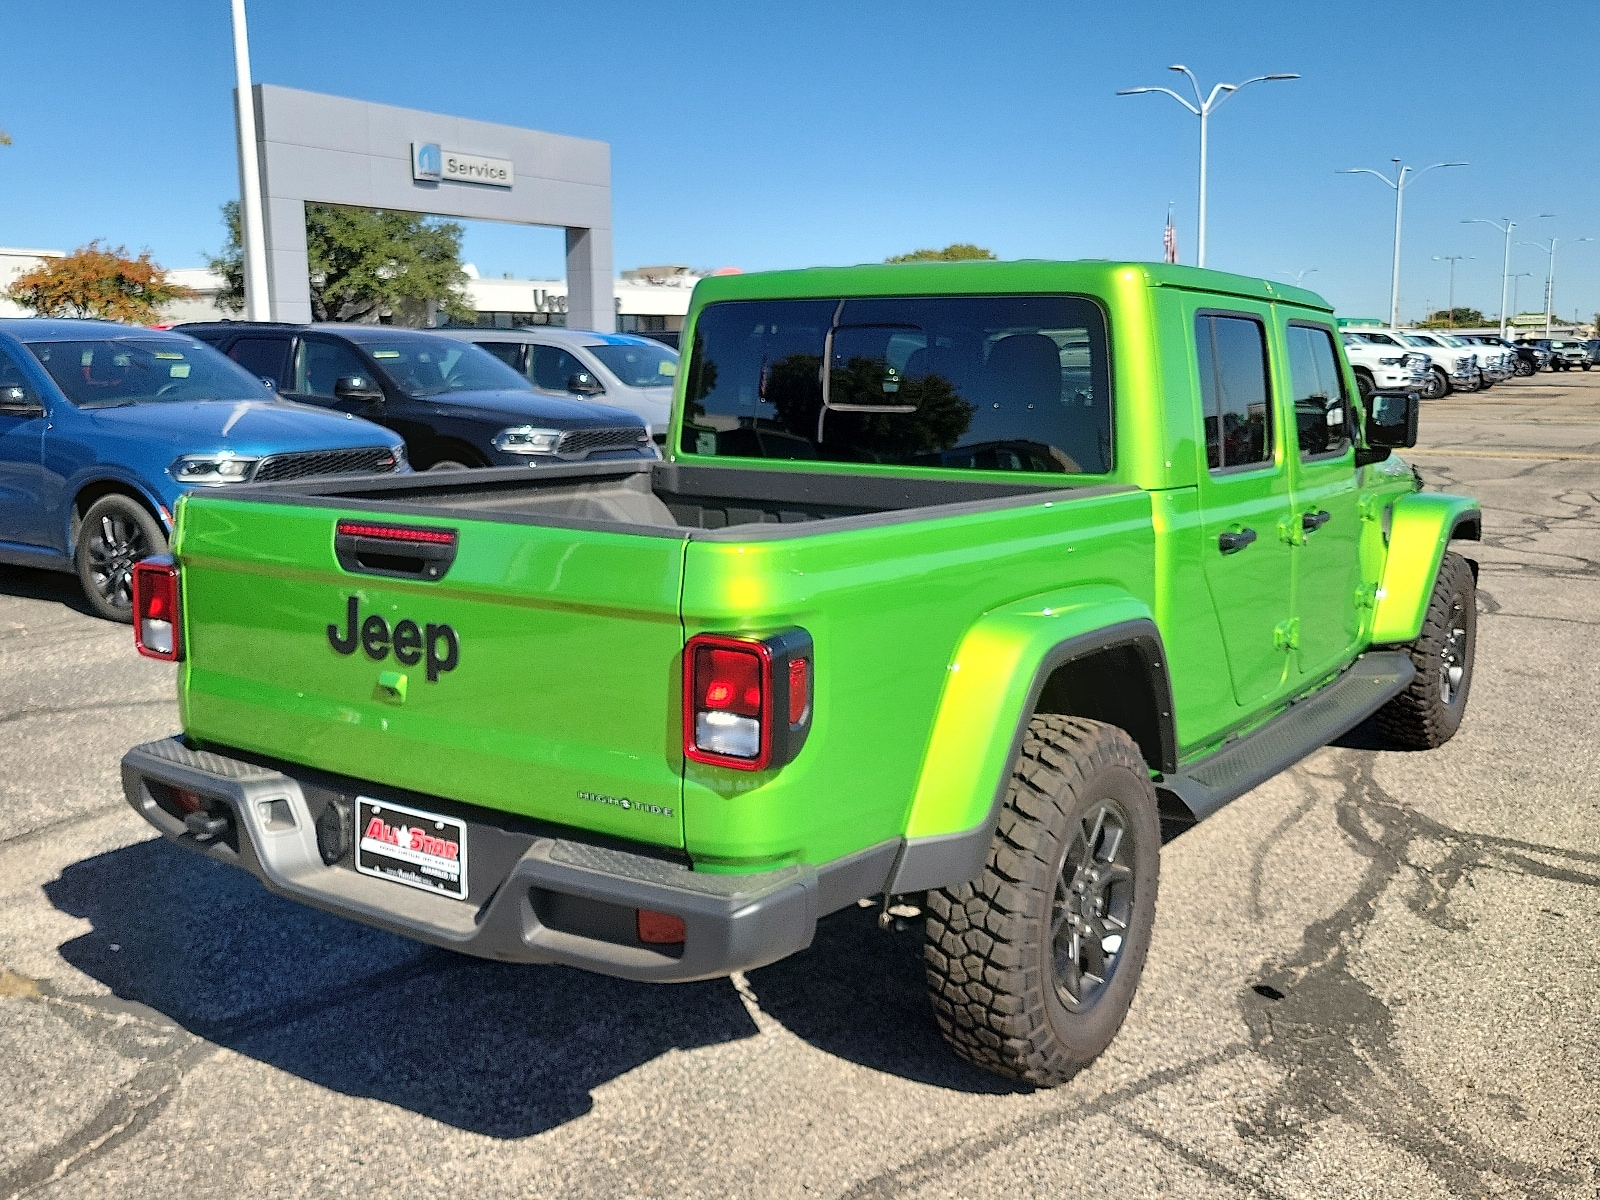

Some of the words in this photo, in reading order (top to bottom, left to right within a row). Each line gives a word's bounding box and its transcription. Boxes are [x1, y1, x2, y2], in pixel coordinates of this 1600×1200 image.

[447, 158, 507, 180] Service
[533, 289, 568, 313] Use
[327, 596, 460, 682] Jeep
[577, 791, 620, 806] HIGH
[633, 801, 674, 817] TIDE
